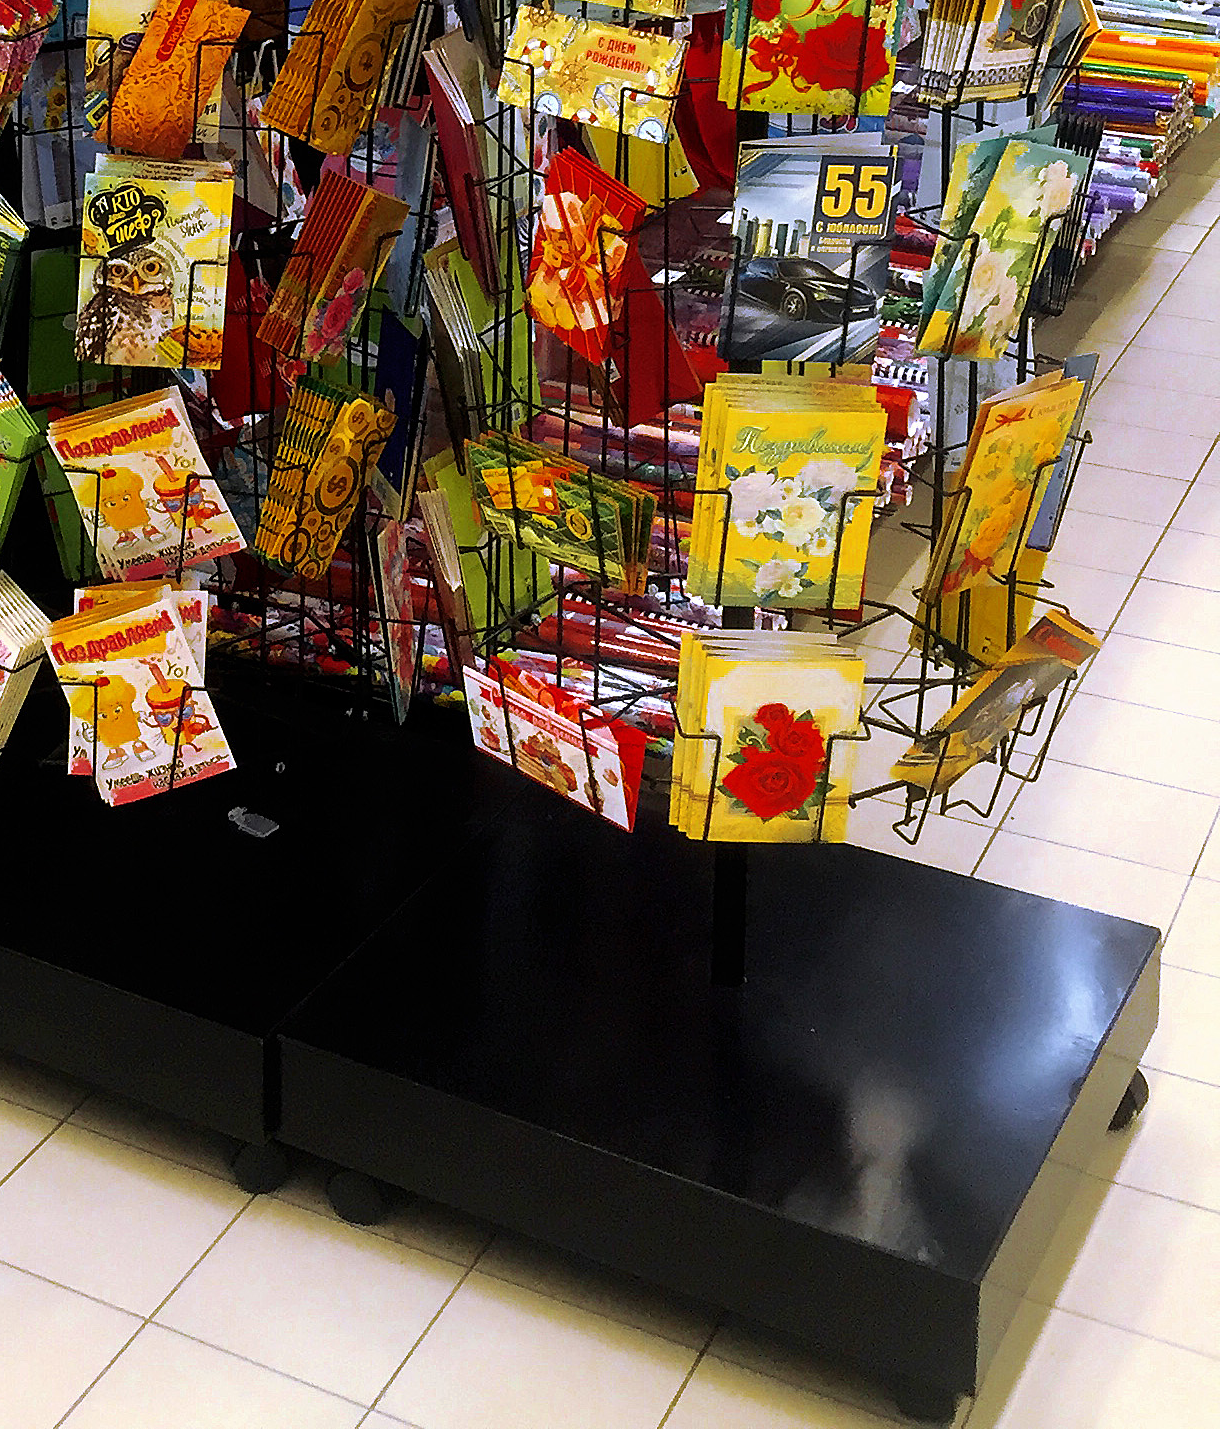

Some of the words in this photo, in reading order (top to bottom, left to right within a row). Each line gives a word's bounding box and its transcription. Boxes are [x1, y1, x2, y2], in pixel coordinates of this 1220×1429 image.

[598, 37, 605, 49] С
[606, 39, 637, 55] ДНЕМ
[586, 51, 646, 72] РОЖДЕНИЯ!
[111, 187, 140, 212] КТО
[822, 164, 888, 218] 55
[816, 220, 823, 232] С
